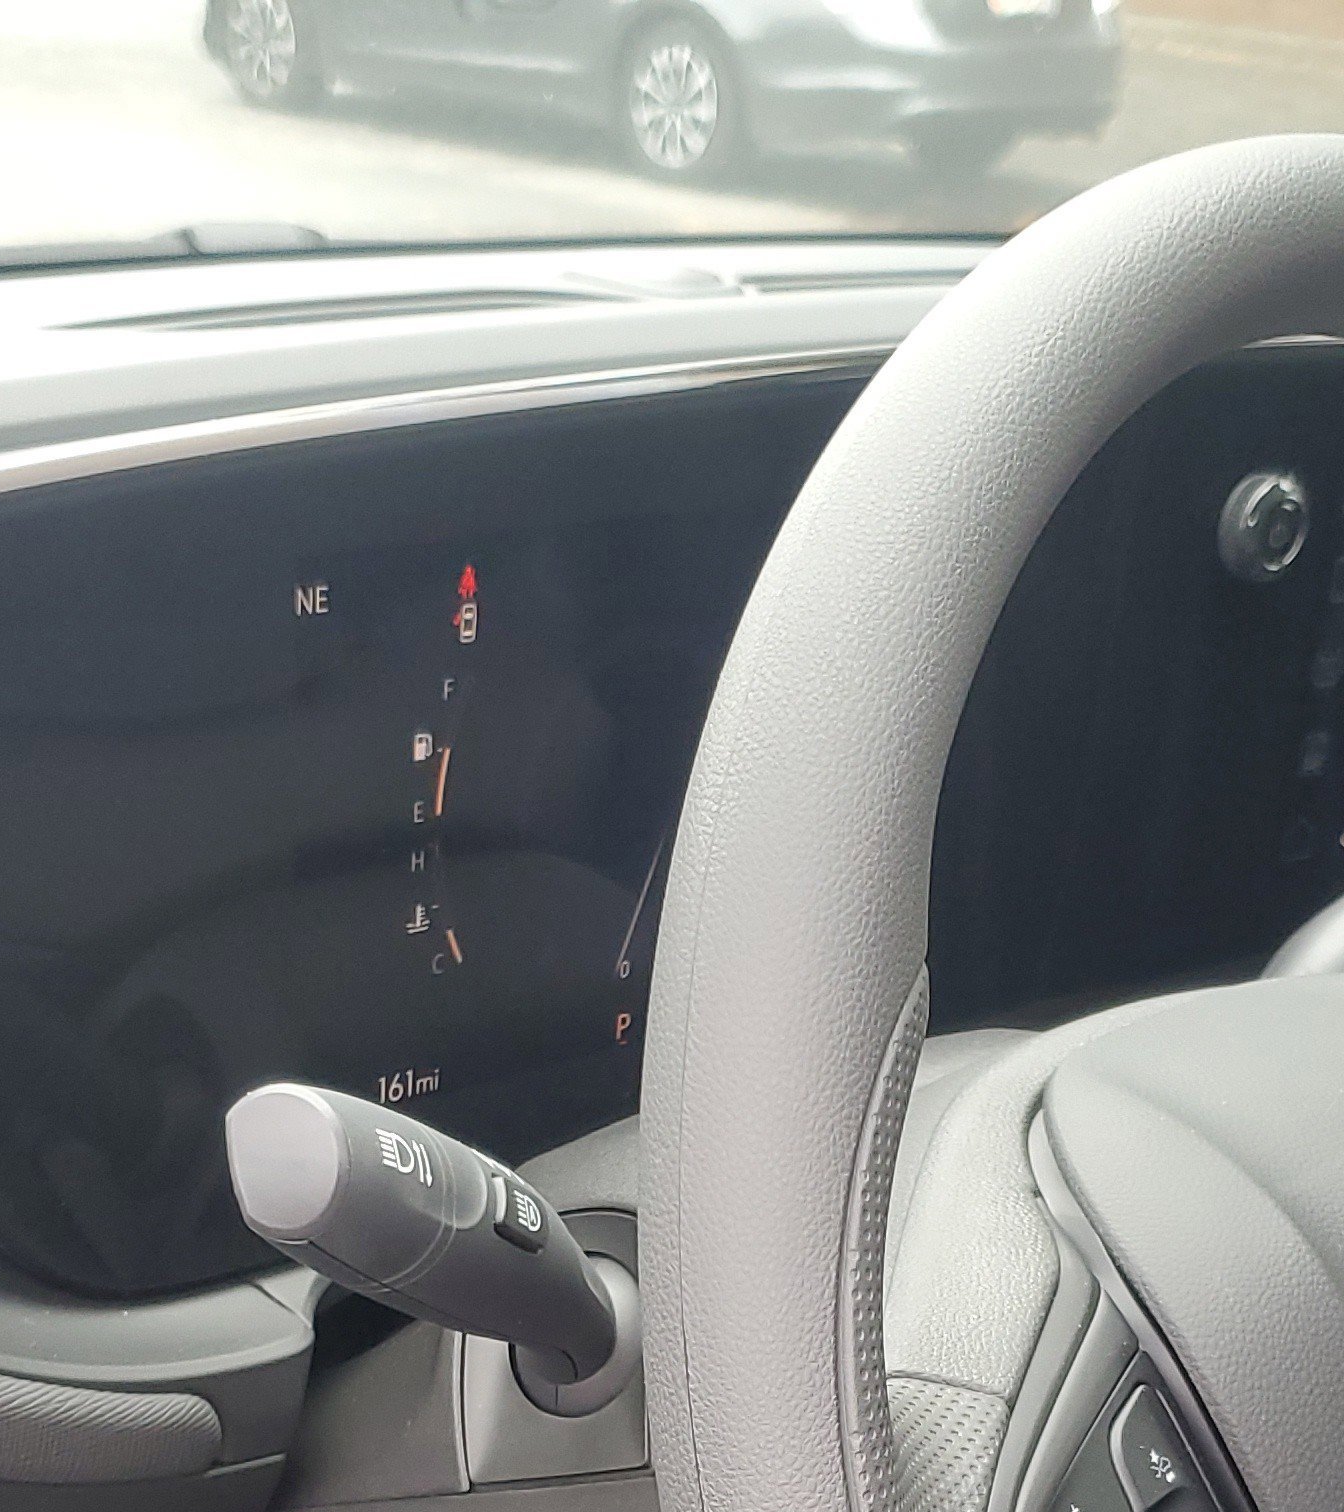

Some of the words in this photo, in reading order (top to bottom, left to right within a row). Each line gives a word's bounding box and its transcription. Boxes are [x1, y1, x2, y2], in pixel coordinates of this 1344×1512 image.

[295, 585, 329, 616] NE
[443, 679, 455, 700] F
[413, 801, 425, 822] E
[411, 851, 424, 871] H
[431, 953, 444, 974] C
[616, 1012, 632, 1040] P
